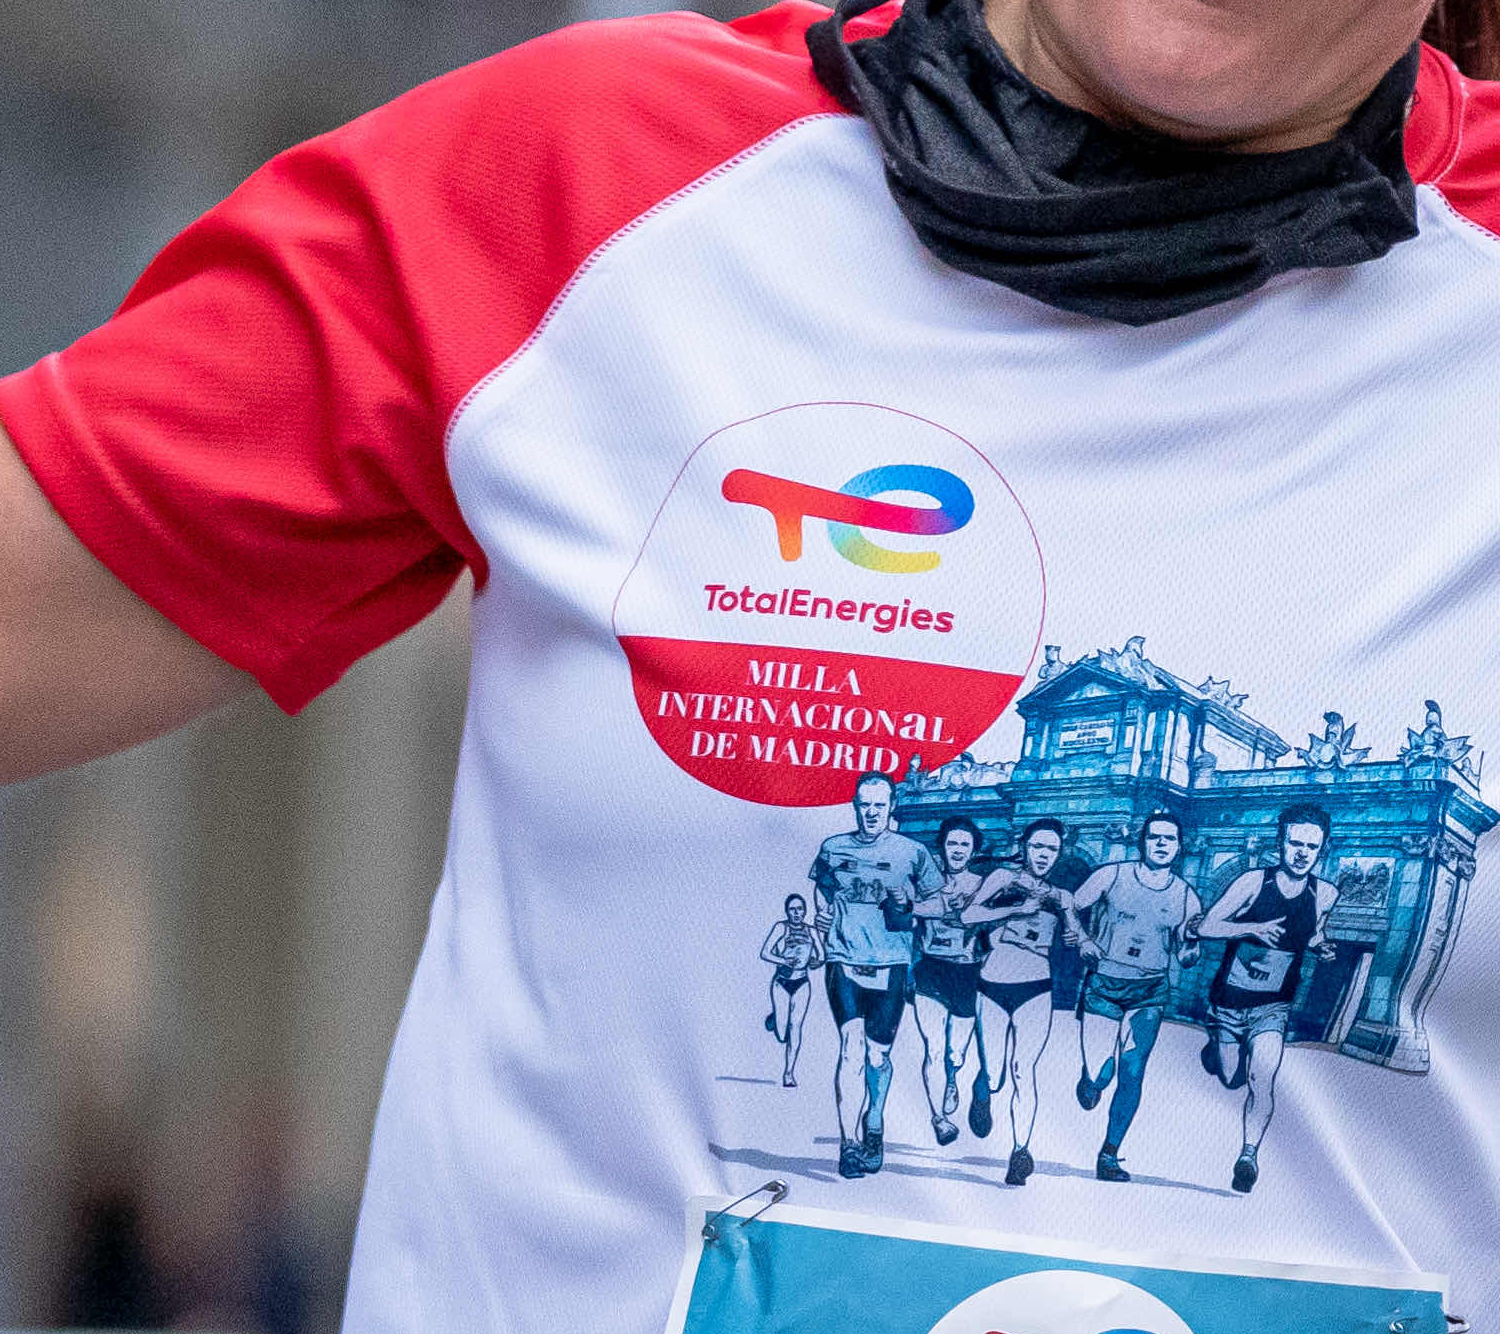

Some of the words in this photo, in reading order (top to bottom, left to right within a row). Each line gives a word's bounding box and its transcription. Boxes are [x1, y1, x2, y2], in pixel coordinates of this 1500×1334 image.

[704, 584, 955, 634] TotalEnergies
[746, 659, 861, 696] MILLA
[690, 730, 739, 759] DE
[749, 734, 901, 774] MADRID
